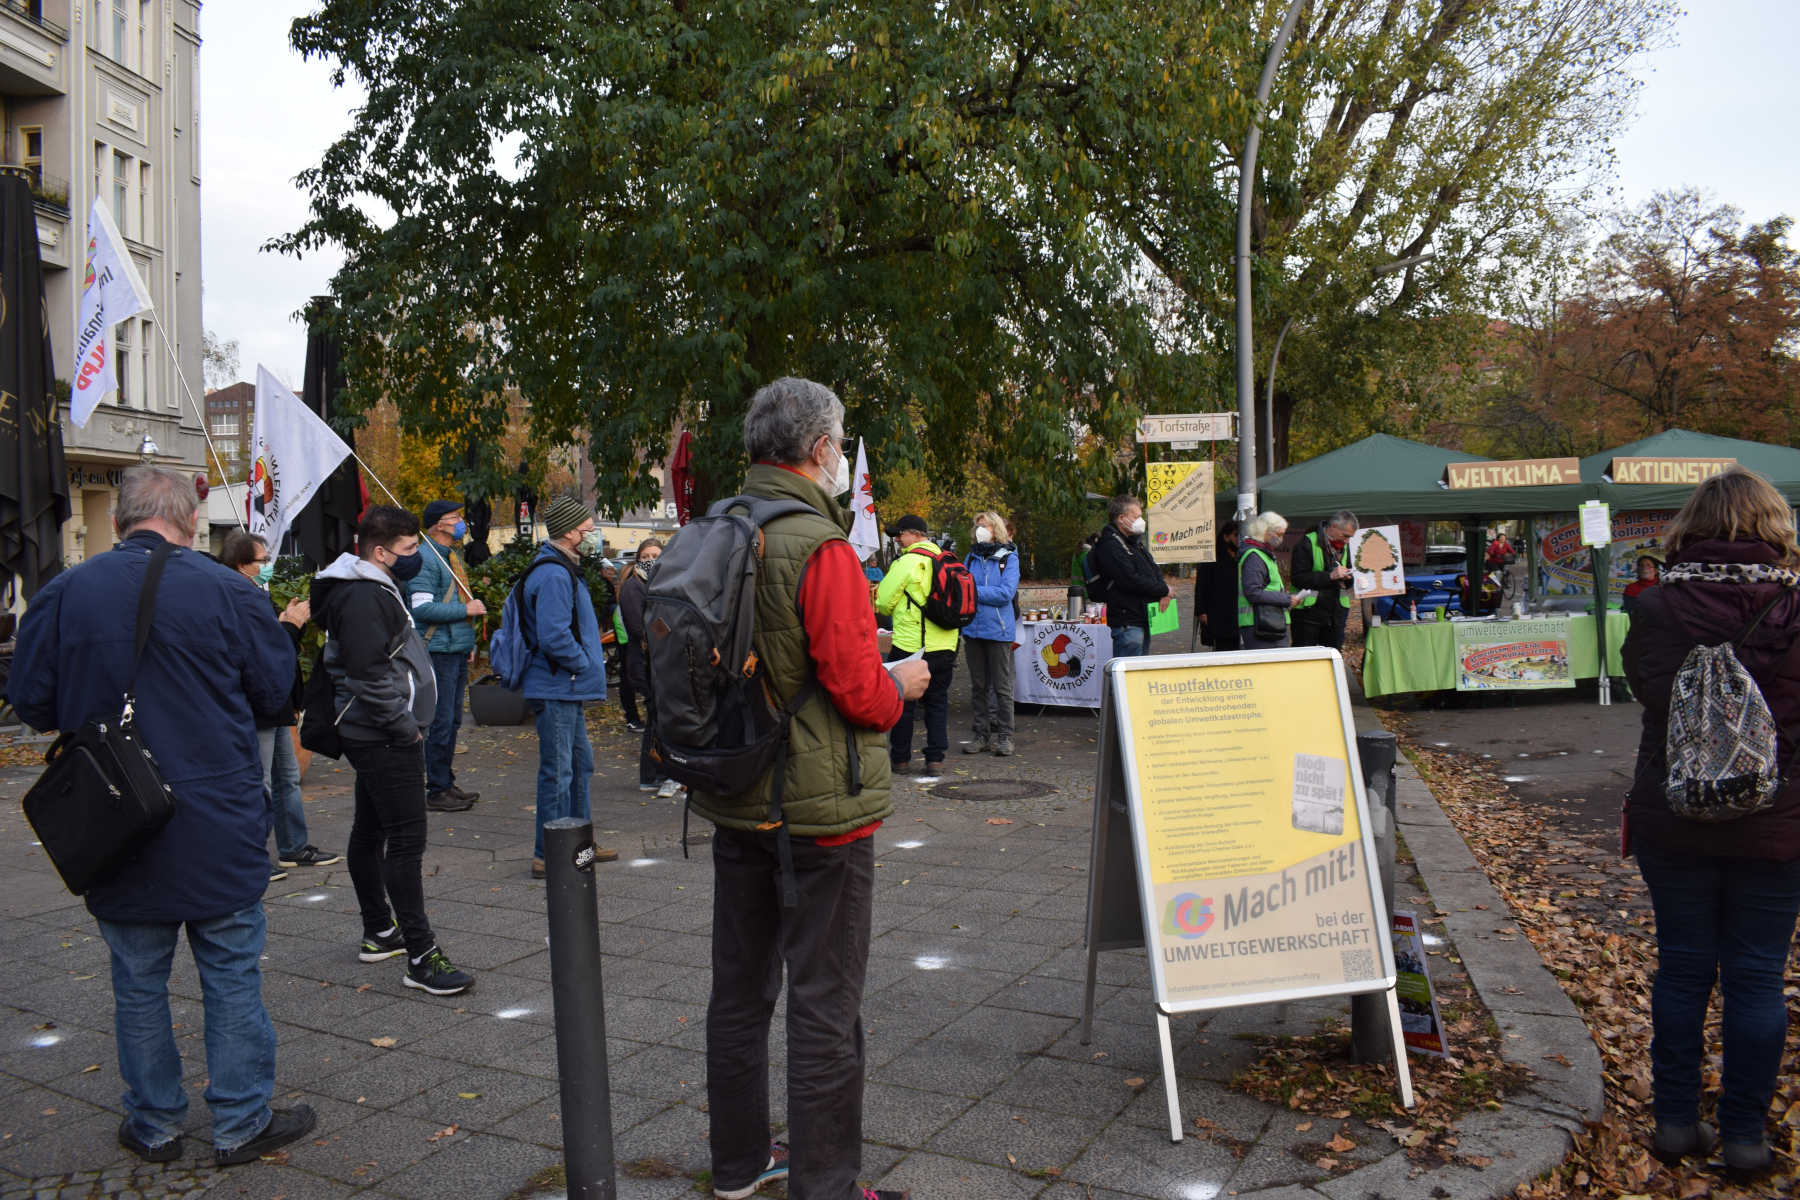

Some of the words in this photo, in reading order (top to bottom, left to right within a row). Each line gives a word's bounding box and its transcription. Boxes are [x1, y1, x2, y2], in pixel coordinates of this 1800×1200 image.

[1158, 419, 1210, 434] Torfstraße
[1616, 462, 1729, 483] AKTIONSTA
[1170, 525, 1194, 543] Mach
[1195, 519, 1213, 534] mit!
[1033, 623, 1095, 648] SOLIDARITÄT
[1031, 660, 1096, 691] INTERNATIONAL
[1147, 677, 1254, 696] Hauptfaktoren
[1175, 695, 1225, 706] Entwicklung
[1223, 869, 1297, 931] Mach
[1305, 842, 1356, 897] mit!
[1315, 912, 1338, 929] bei
[1342, 909, 1366, 926] der
[1163, 928, 1371, 964] UMWELTGEWERKSCHAFT
